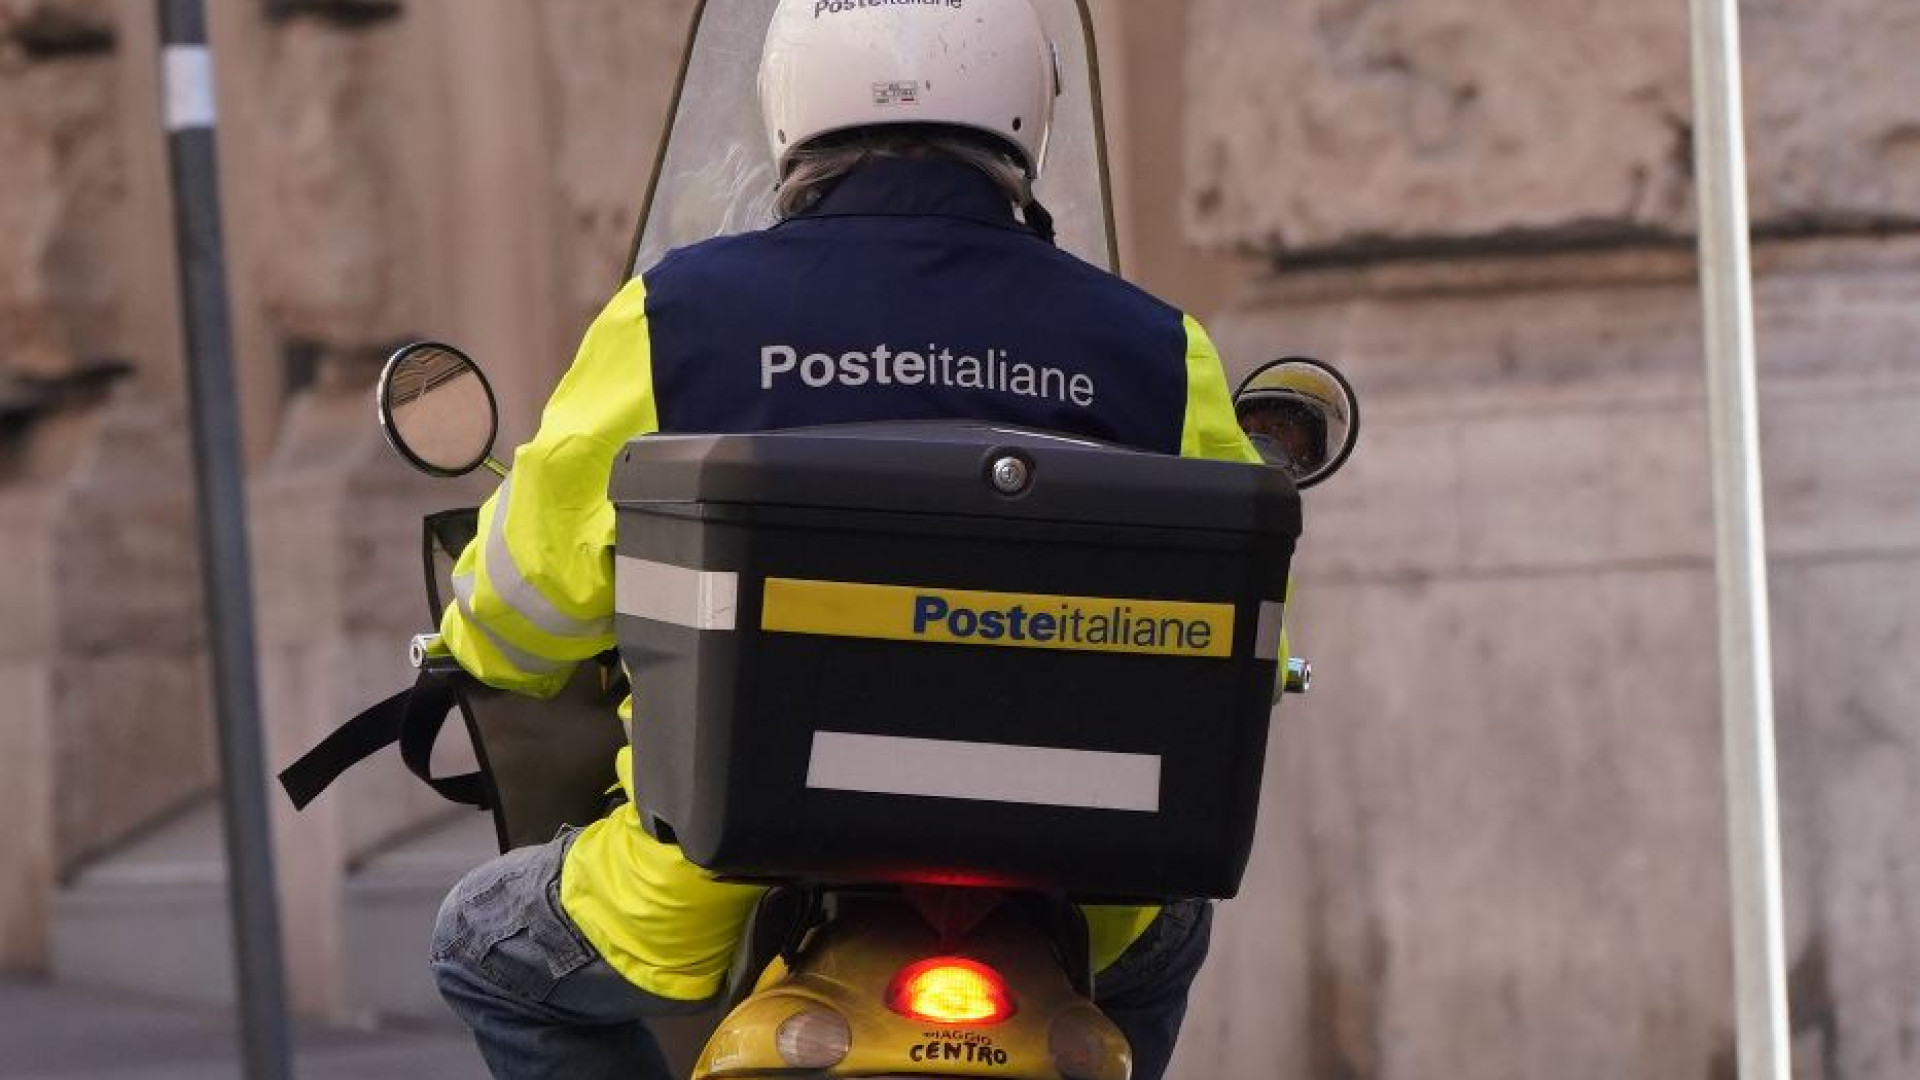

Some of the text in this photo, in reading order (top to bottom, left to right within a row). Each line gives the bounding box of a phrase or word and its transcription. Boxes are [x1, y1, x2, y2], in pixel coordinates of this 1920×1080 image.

[761, 343, 1094, 406] Posteitaliane
[913, 595, 1211, 649] Posteitaliane
[909, 1041, 1007, 1066] CENTRO
